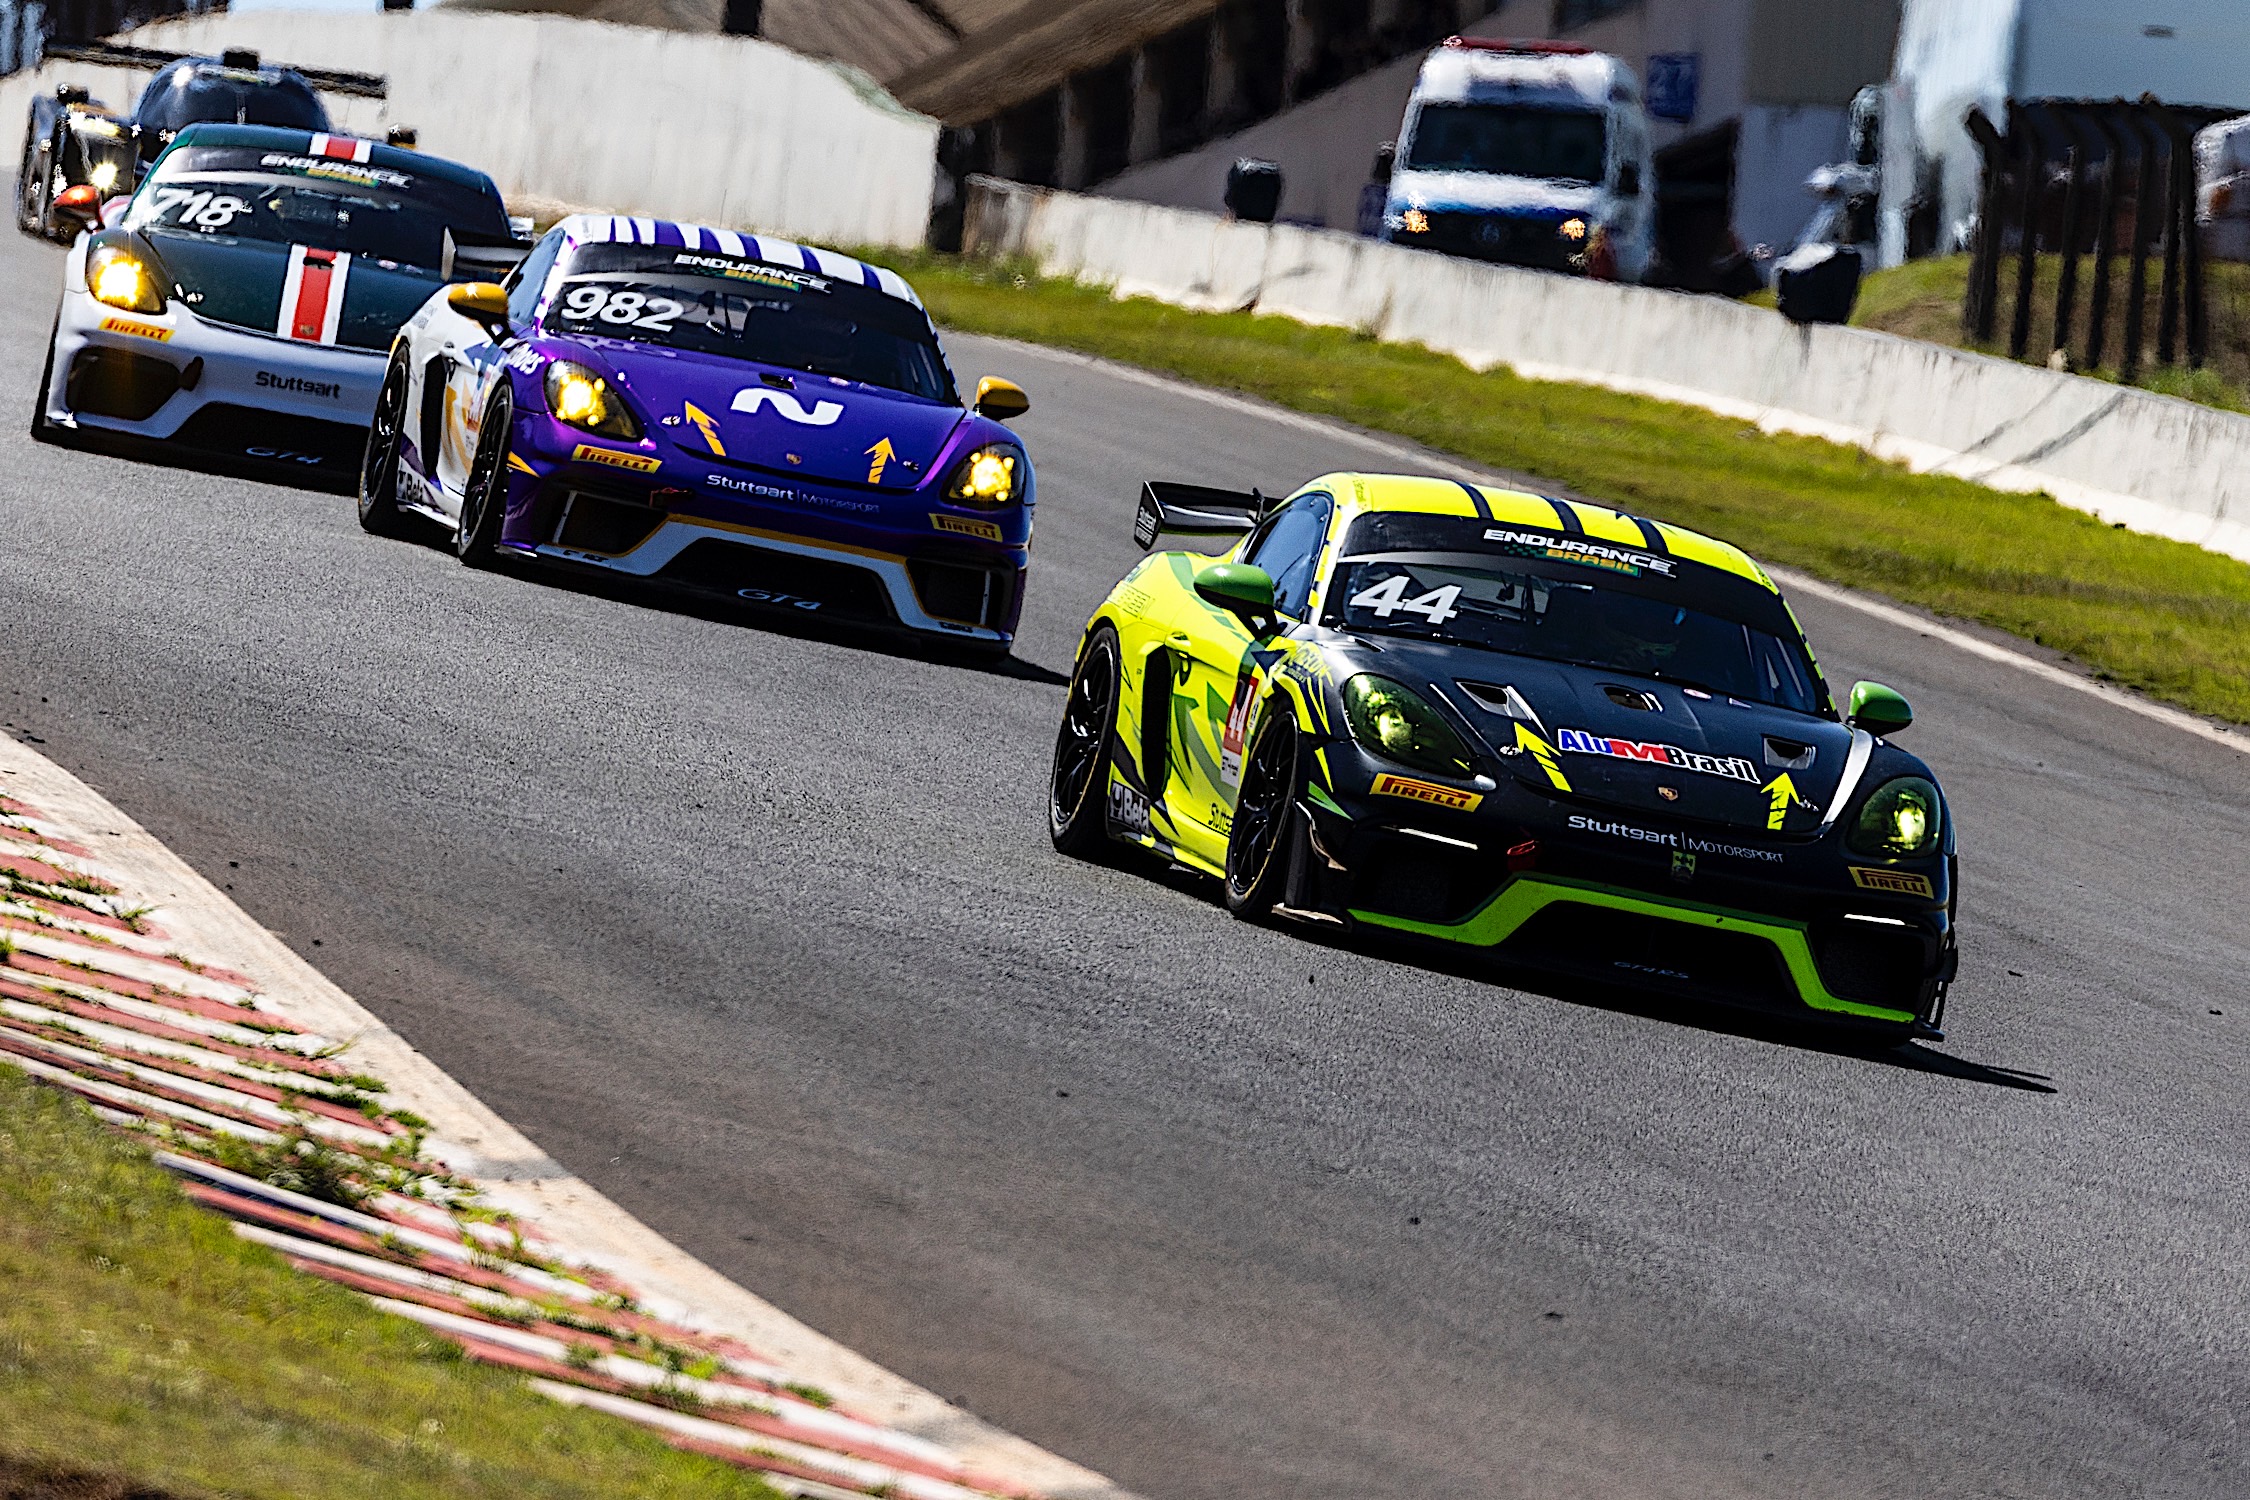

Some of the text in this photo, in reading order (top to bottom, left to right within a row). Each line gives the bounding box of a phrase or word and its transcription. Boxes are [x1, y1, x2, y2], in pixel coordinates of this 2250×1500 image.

[260, 154, 410, 188] ENDURANCE
[152, 188, 243, 226] 718
[674, 253, 829, 290] ENDURANCE
[724, 269, 797, 289] BRASIL
[561, 286, 684, 332] 982
[255, 371, 340, 399] Stuttgart
[582, 446, 654, 471] PIRELLI
[707, 474, 794, 501] Stuttgart
[936, 514, 996, 539] PIRELLI
[1484, 529, 1674, 574] ENDURANCE
[1546, 548, 1634, 574] BRASIL
[738, 588, 822, 610] GT4
[1350, 575, 1462, 625] 44
[1558, 728, 1762, 785] AluMBrasil
[1380, 776, 1472, 808] PIRELLI
[1124, 787, 1150, 834] Beta
[1568, 815, 1784, 863] Stuttgart MOTORSPORT
[1857, 868, 1928, 895] PIRELLI
